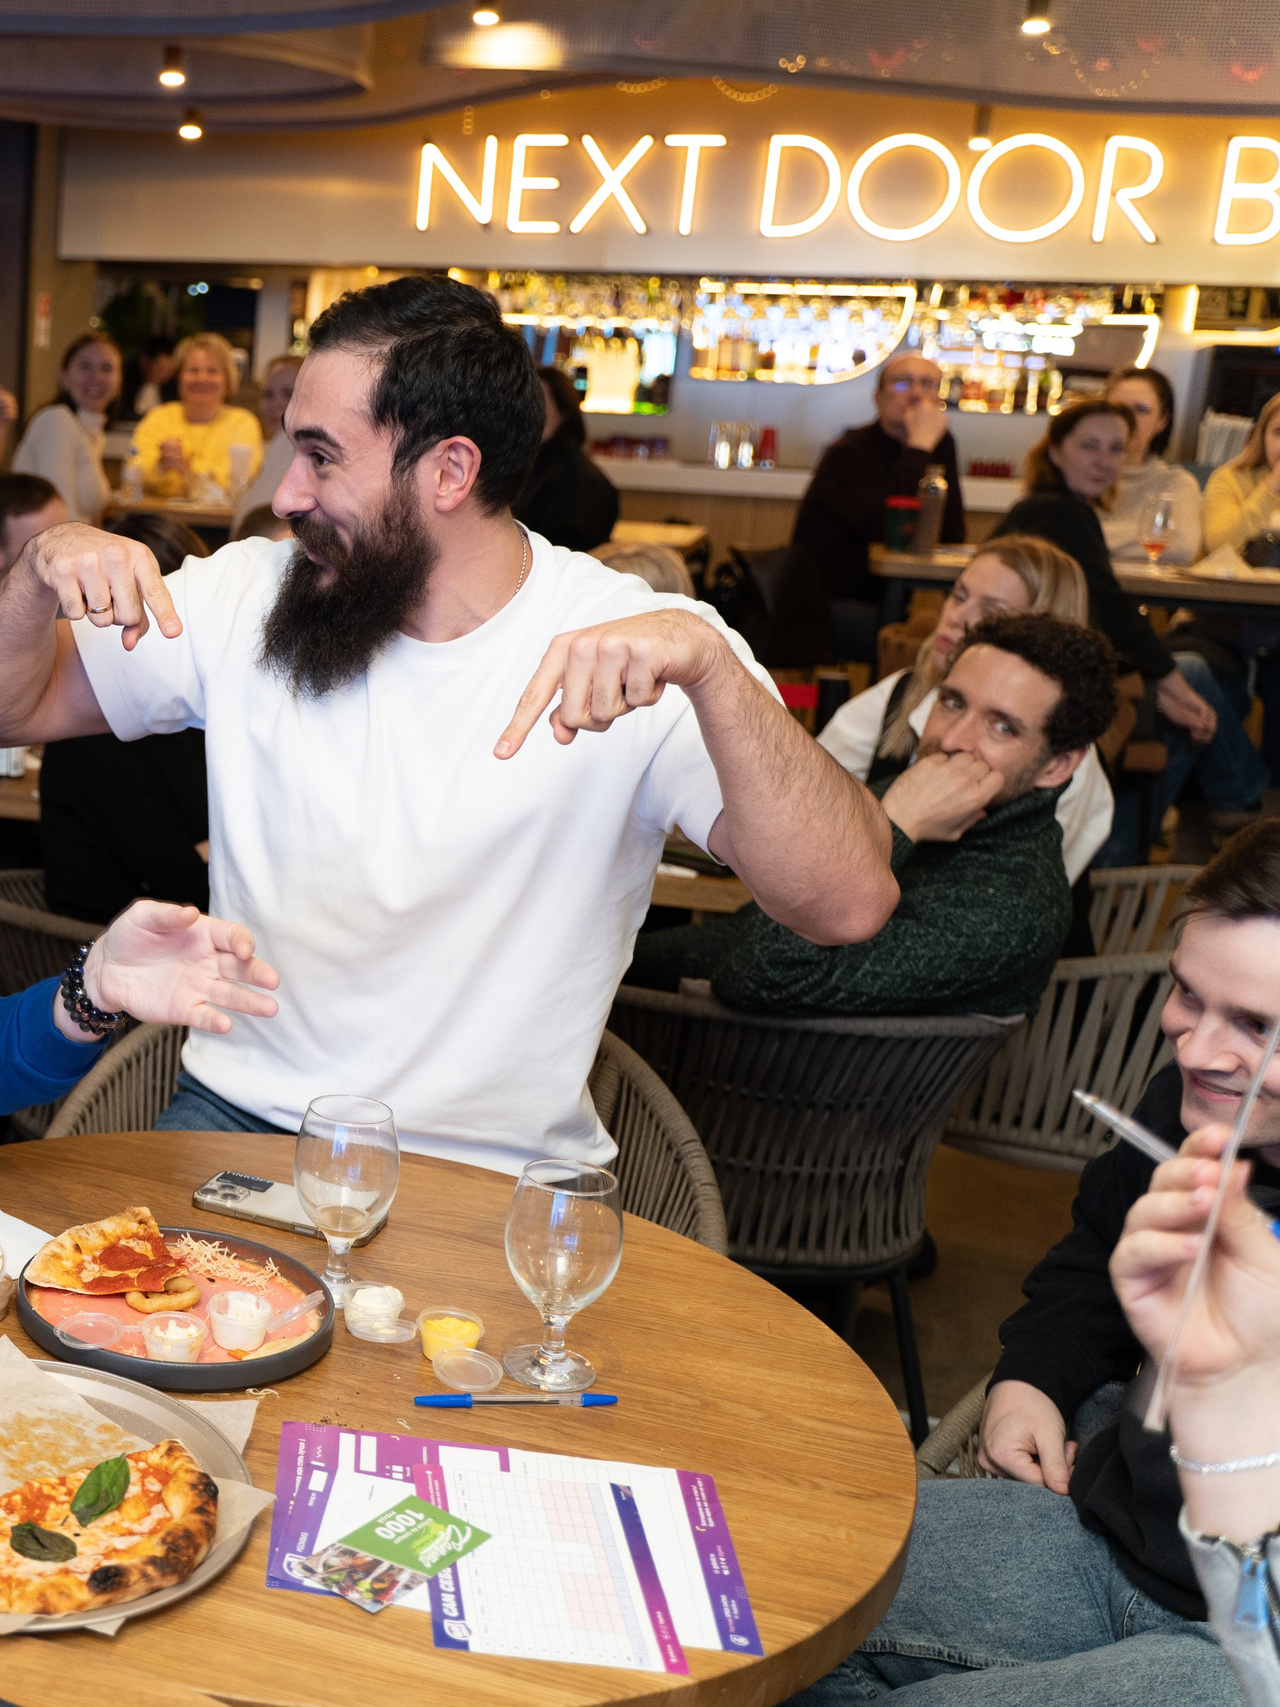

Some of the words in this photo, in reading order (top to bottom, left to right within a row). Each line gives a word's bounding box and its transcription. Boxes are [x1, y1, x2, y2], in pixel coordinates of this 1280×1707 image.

[416, 133, 728, 236] NEXT
[758, 132, 1166, 243] DOOR
[374, 1508, 425, 1540] 1000
[418, 1524, 472, 1567] Canvas
[440, 1593, 458, 1617] САМ
